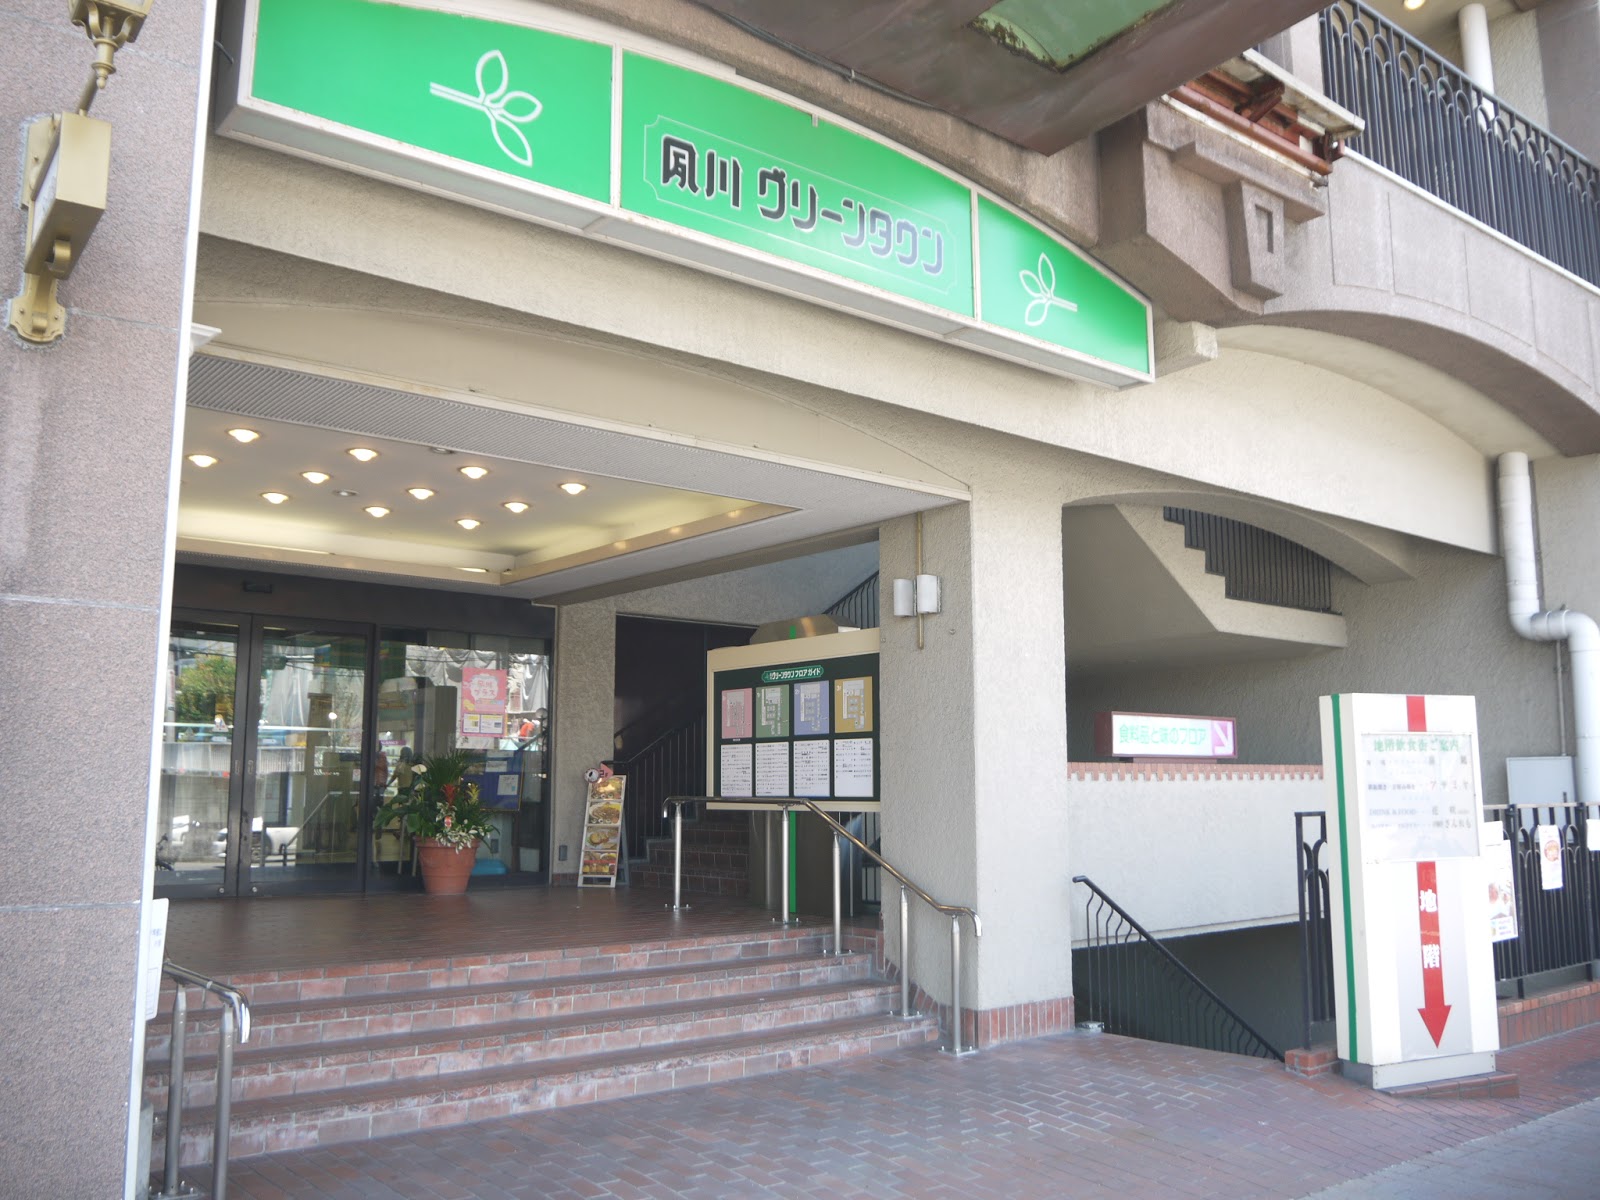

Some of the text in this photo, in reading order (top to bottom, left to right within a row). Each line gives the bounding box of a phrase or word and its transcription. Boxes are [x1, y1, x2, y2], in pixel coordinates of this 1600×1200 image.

[660, 134, 945, 276] 夙川 グリーンタウン
